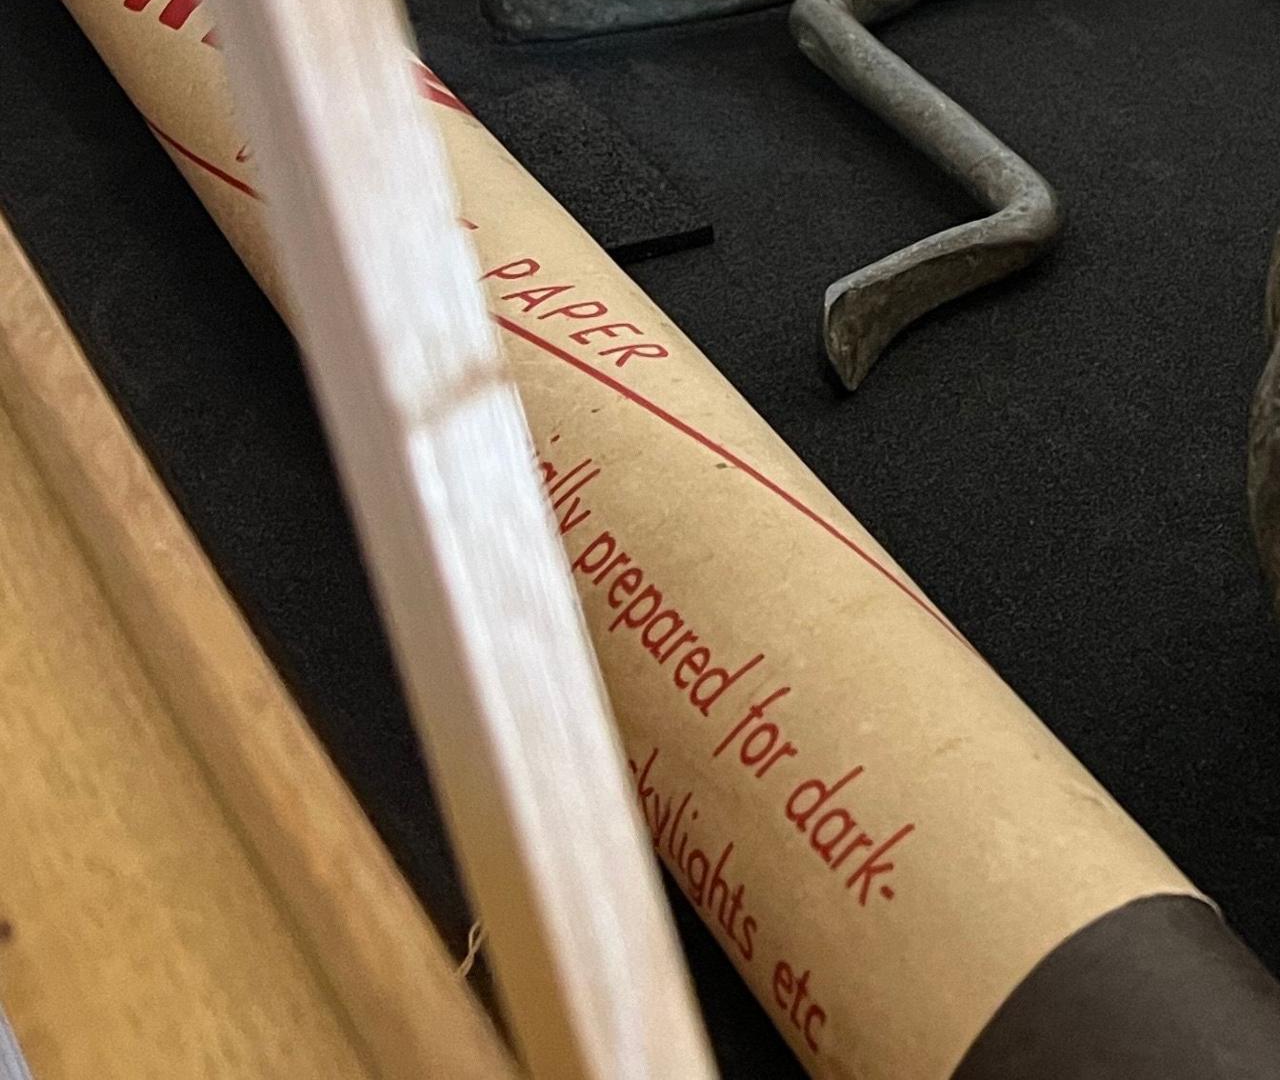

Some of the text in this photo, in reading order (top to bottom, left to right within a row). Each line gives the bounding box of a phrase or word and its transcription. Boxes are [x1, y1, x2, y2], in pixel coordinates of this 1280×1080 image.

[478, 257, 669, 368] PAPER
[571, 530, 765, 718] prepared
[713, 686, 799, 779] for
